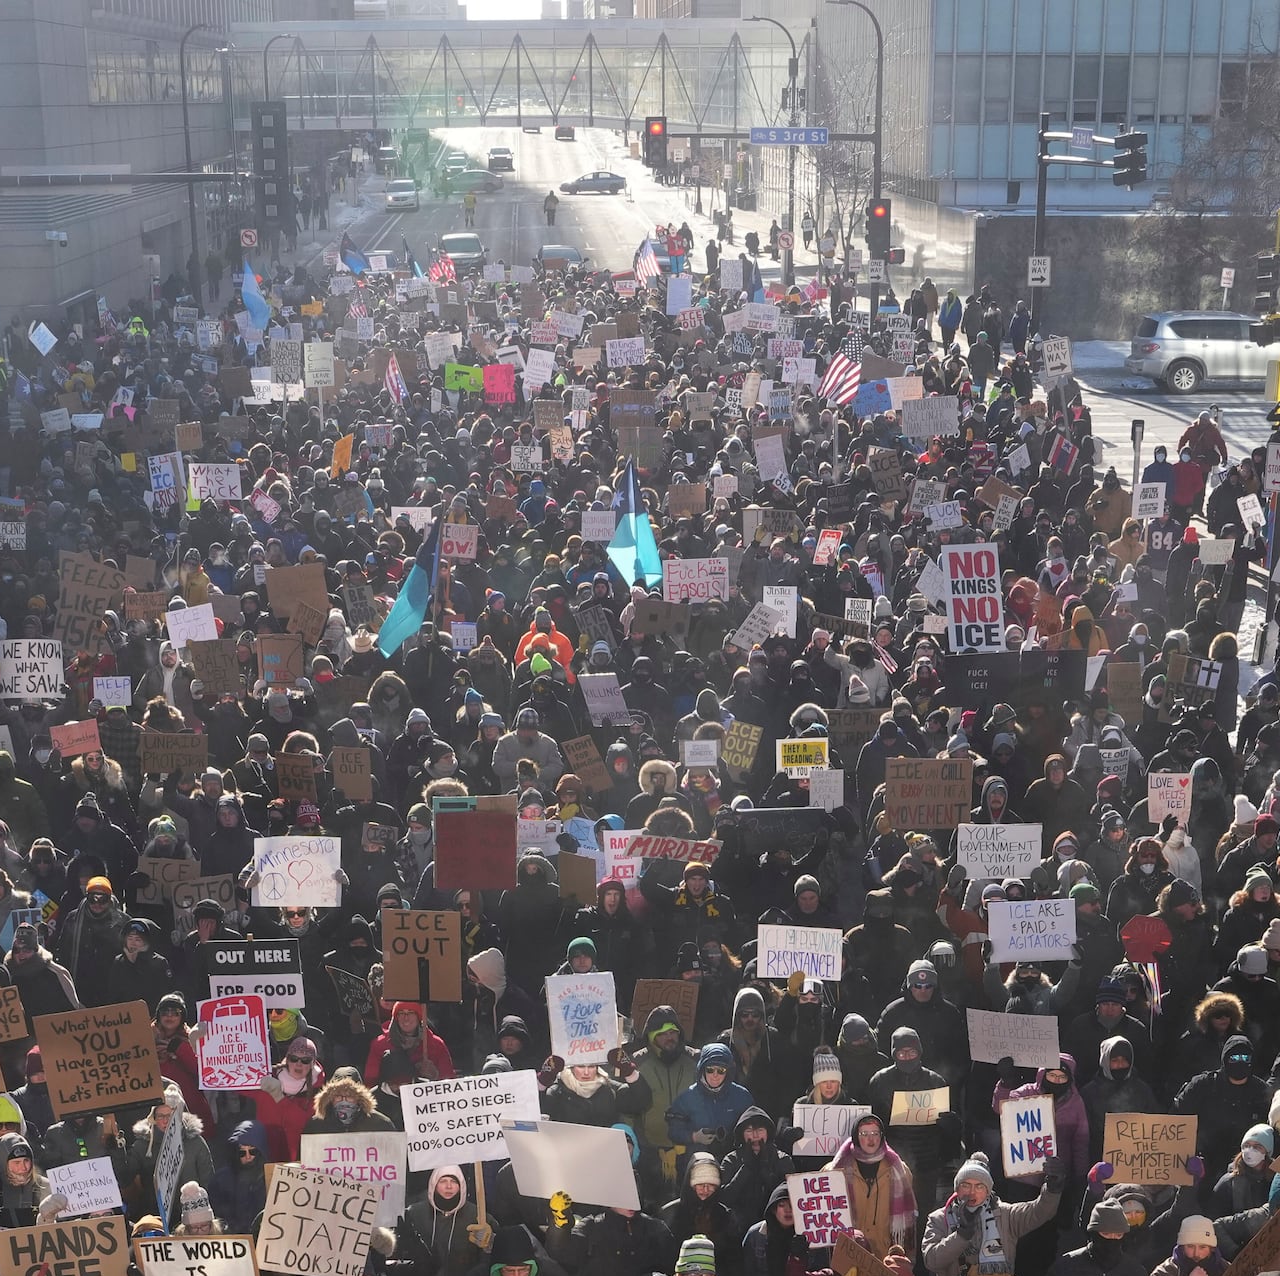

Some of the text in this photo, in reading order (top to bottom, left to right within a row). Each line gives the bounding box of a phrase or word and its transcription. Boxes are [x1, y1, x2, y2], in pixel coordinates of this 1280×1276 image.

[768, 129, 825, 141] S 3rd St
[1032, 258, 1048, 267] ONE
[1032, 267, 1047, 275] WAY
[1046, 341, 1067, 352] ONE
[1046, 351, 1068, 363] WAY
[514, 447, 536, 457] STOP
[191, 465, 233, 478] What
[512, 461, 542, 471] VIOLENCE
[192, 477, 224, 488] The
[199, 485, 238, 498] FUCK
[1152, 531, 1173, 550] 84
[948, 550, 994, 579] NO
[951, 578, 996, 595] KINGS
[953, 596, 999, 624] NO
[954, 625, 1000, 647] ICE
[3, 641, 62, 660] WE KNOW
[15, 662, 49, 673] WHAT
[968, 670, 988, 678] FUCK
[3, 676, 21, 693] WE
[971, 682, 988, 690] ICE!
[731, 722, 762, 741] ICE
[727, 736, 758, 756] OUT
[723, 751, 754, 769] NOW
[1150, 779, 1174, 788] LOVE
[1159, 789, 1186, 800] MELTS
[964, 826, 1006, 840] YOUR
[628, 836, 720, 863] MURDER
[959, 840, 1038, 853] GOVERNMENT
[967, 852, 1032, 864] IS LYING TO
[1009, 902, 1065, 919] ICE ARE
[395, 912, 447, 931] ICE
[1021, 921, 1047, 933] PAID
[392, 936, 447, 956] OUT
[1009, 933, 1070, 949] AGITATORS
[215, 949, 292, 964] OUT HERE
[216, 982, 297, 997] FOR GOOD
[51, 1012, 131, 1034] What Would
[73, 1030, 120, 1052] YOU
[55, 1047, 149, 1073] Have Done In
[97, 1079, 128, 1096] Find
[129, 1075, 154, 1091] Out
[413, 1077, 499, 1097] OPERATION
[415, 1098, 467, 1114] METRO
[419, 1113, 501, 1133] 0% SAFETY
[1117, 1123, 1186, 1142] RELEASE
[408, 1131, 504, 1152] 100% OCCUPA
[1134, 1142, 1157, 1152] THE
[1106, 1151, 1190, 1169] TRUMPSTEIN
[1131, 1168, 1170, 1181] FILES
[11, 1221, 117, 1266] HANDS
[140, 1240, 247, 1263] THE WORLD
